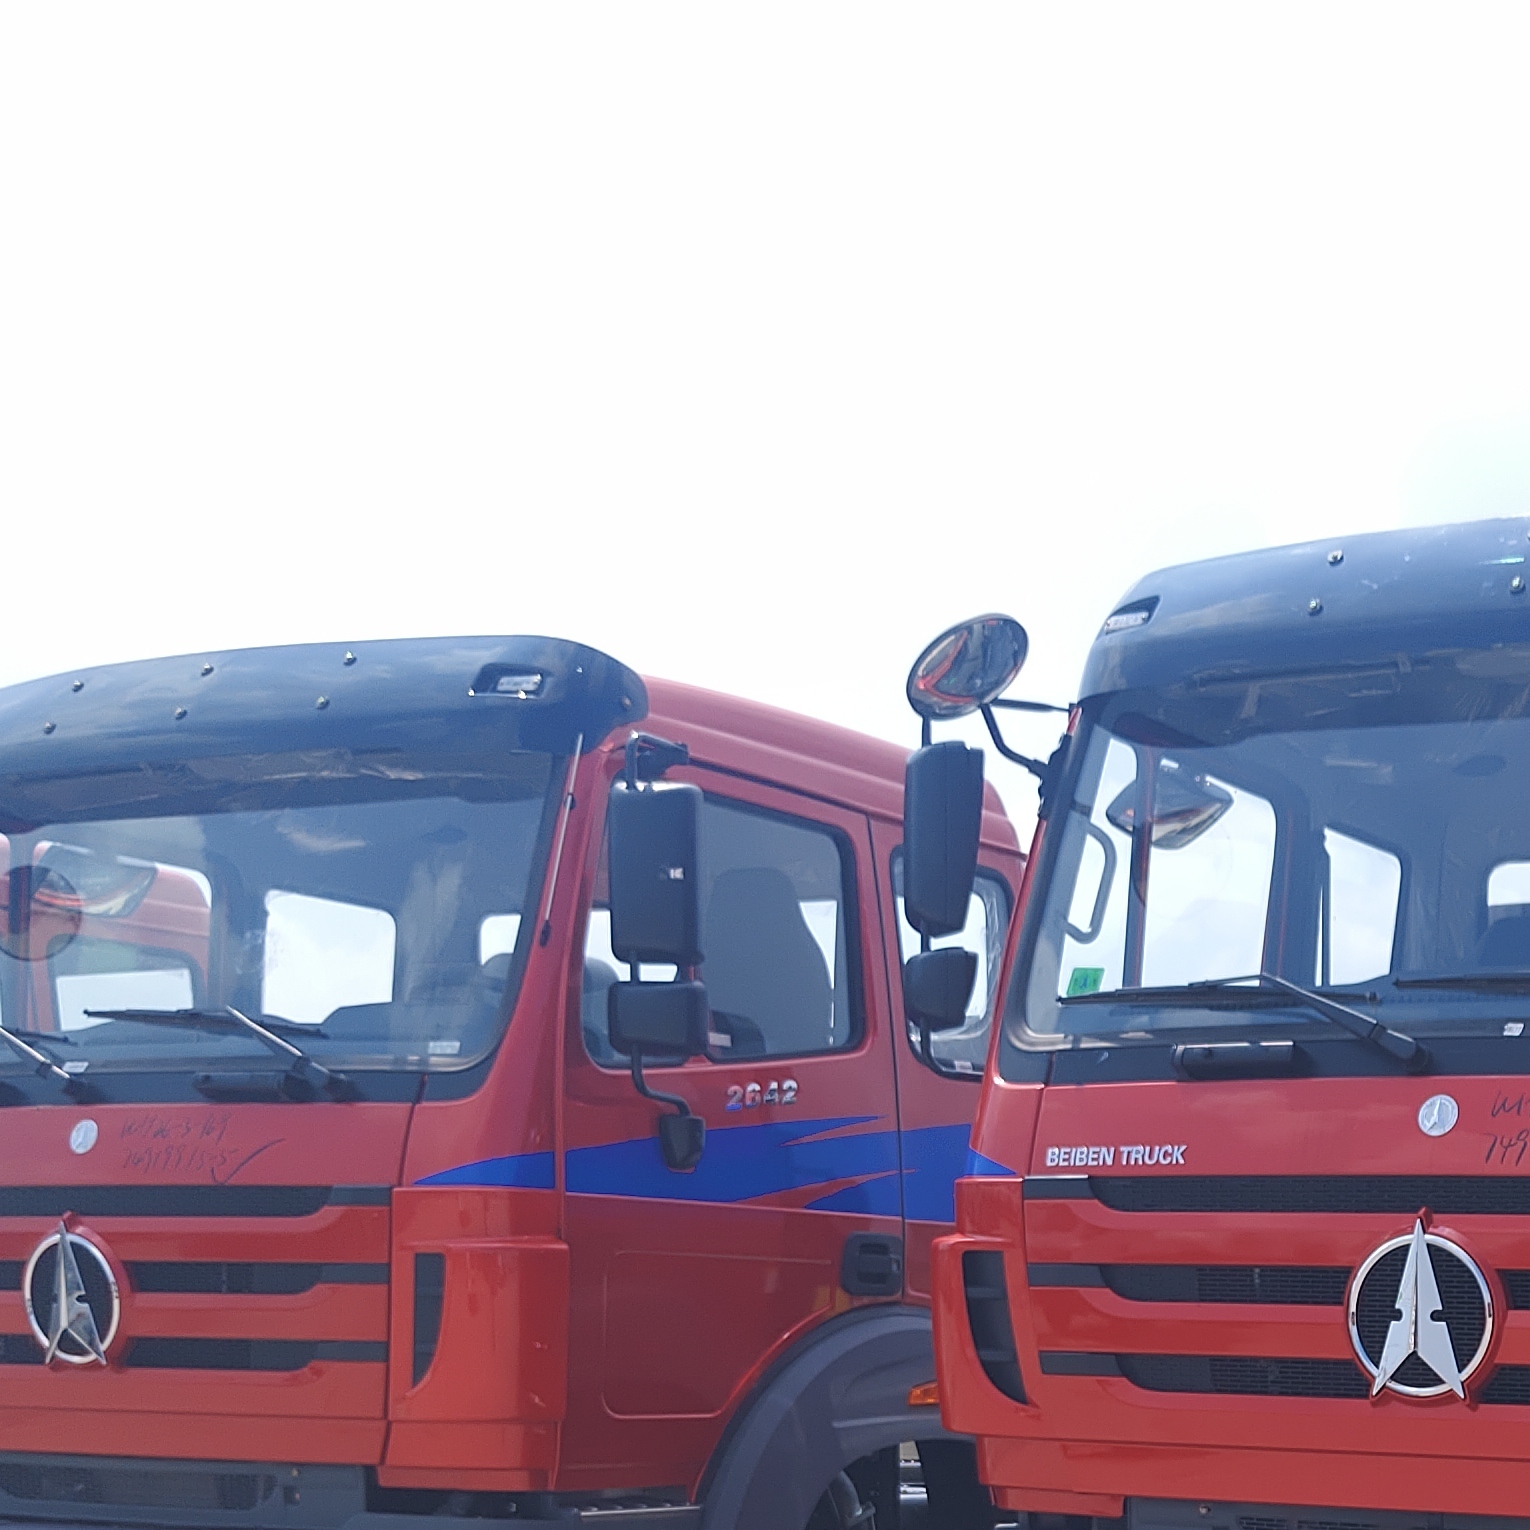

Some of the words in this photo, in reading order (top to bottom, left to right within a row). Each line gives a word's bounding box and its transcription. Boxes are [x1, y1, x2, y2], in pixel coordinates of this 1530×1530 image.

[725, 1079, 798, 1112] 2642
[1045, 1145, 1116, 1167] BEIBEN
[1119, 1143, 1188, 1166] TRUCK
